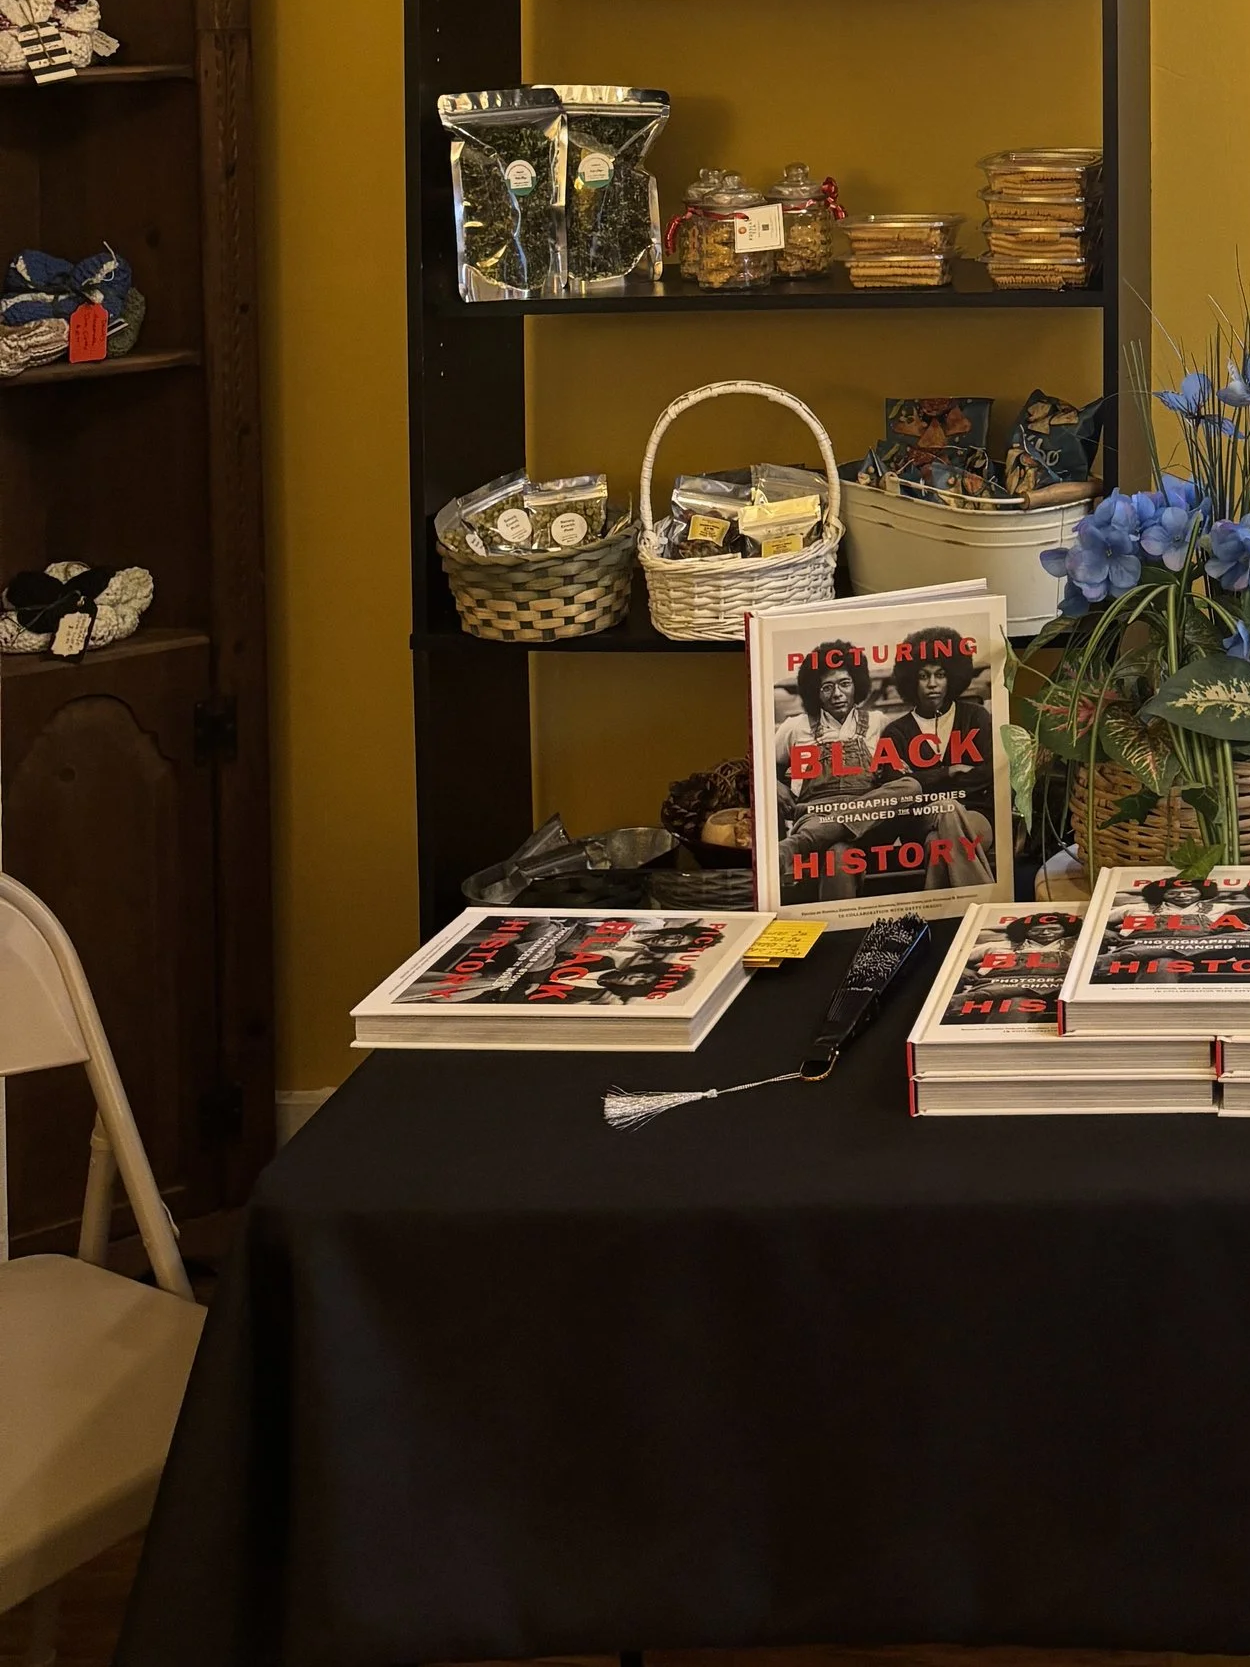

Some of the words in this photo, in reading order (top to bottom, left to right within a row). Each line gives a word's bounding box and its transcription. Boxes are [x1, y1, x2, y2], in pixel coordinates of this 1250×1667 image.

[787, 637, 978, 671] PICTURING
[789, 728, 985, 780] BLACK
[807, 797, 898, 814] PHOTOGRAPHS
[915, 790, 966, 803] STORIES
[836, 810, 895, 824] CHANGED
[913, 804, 955, 816] WORLD
[792, 834, 985, 881] HISTORY
[428, 920, 530, 999] HISTORY
[528, 921, 636, 1001] BLACK
[646, 923, 729, 1000] PICTURING
[979, 952, 1060, 968] BL
[961, 999, 1047, 1014] HIS
